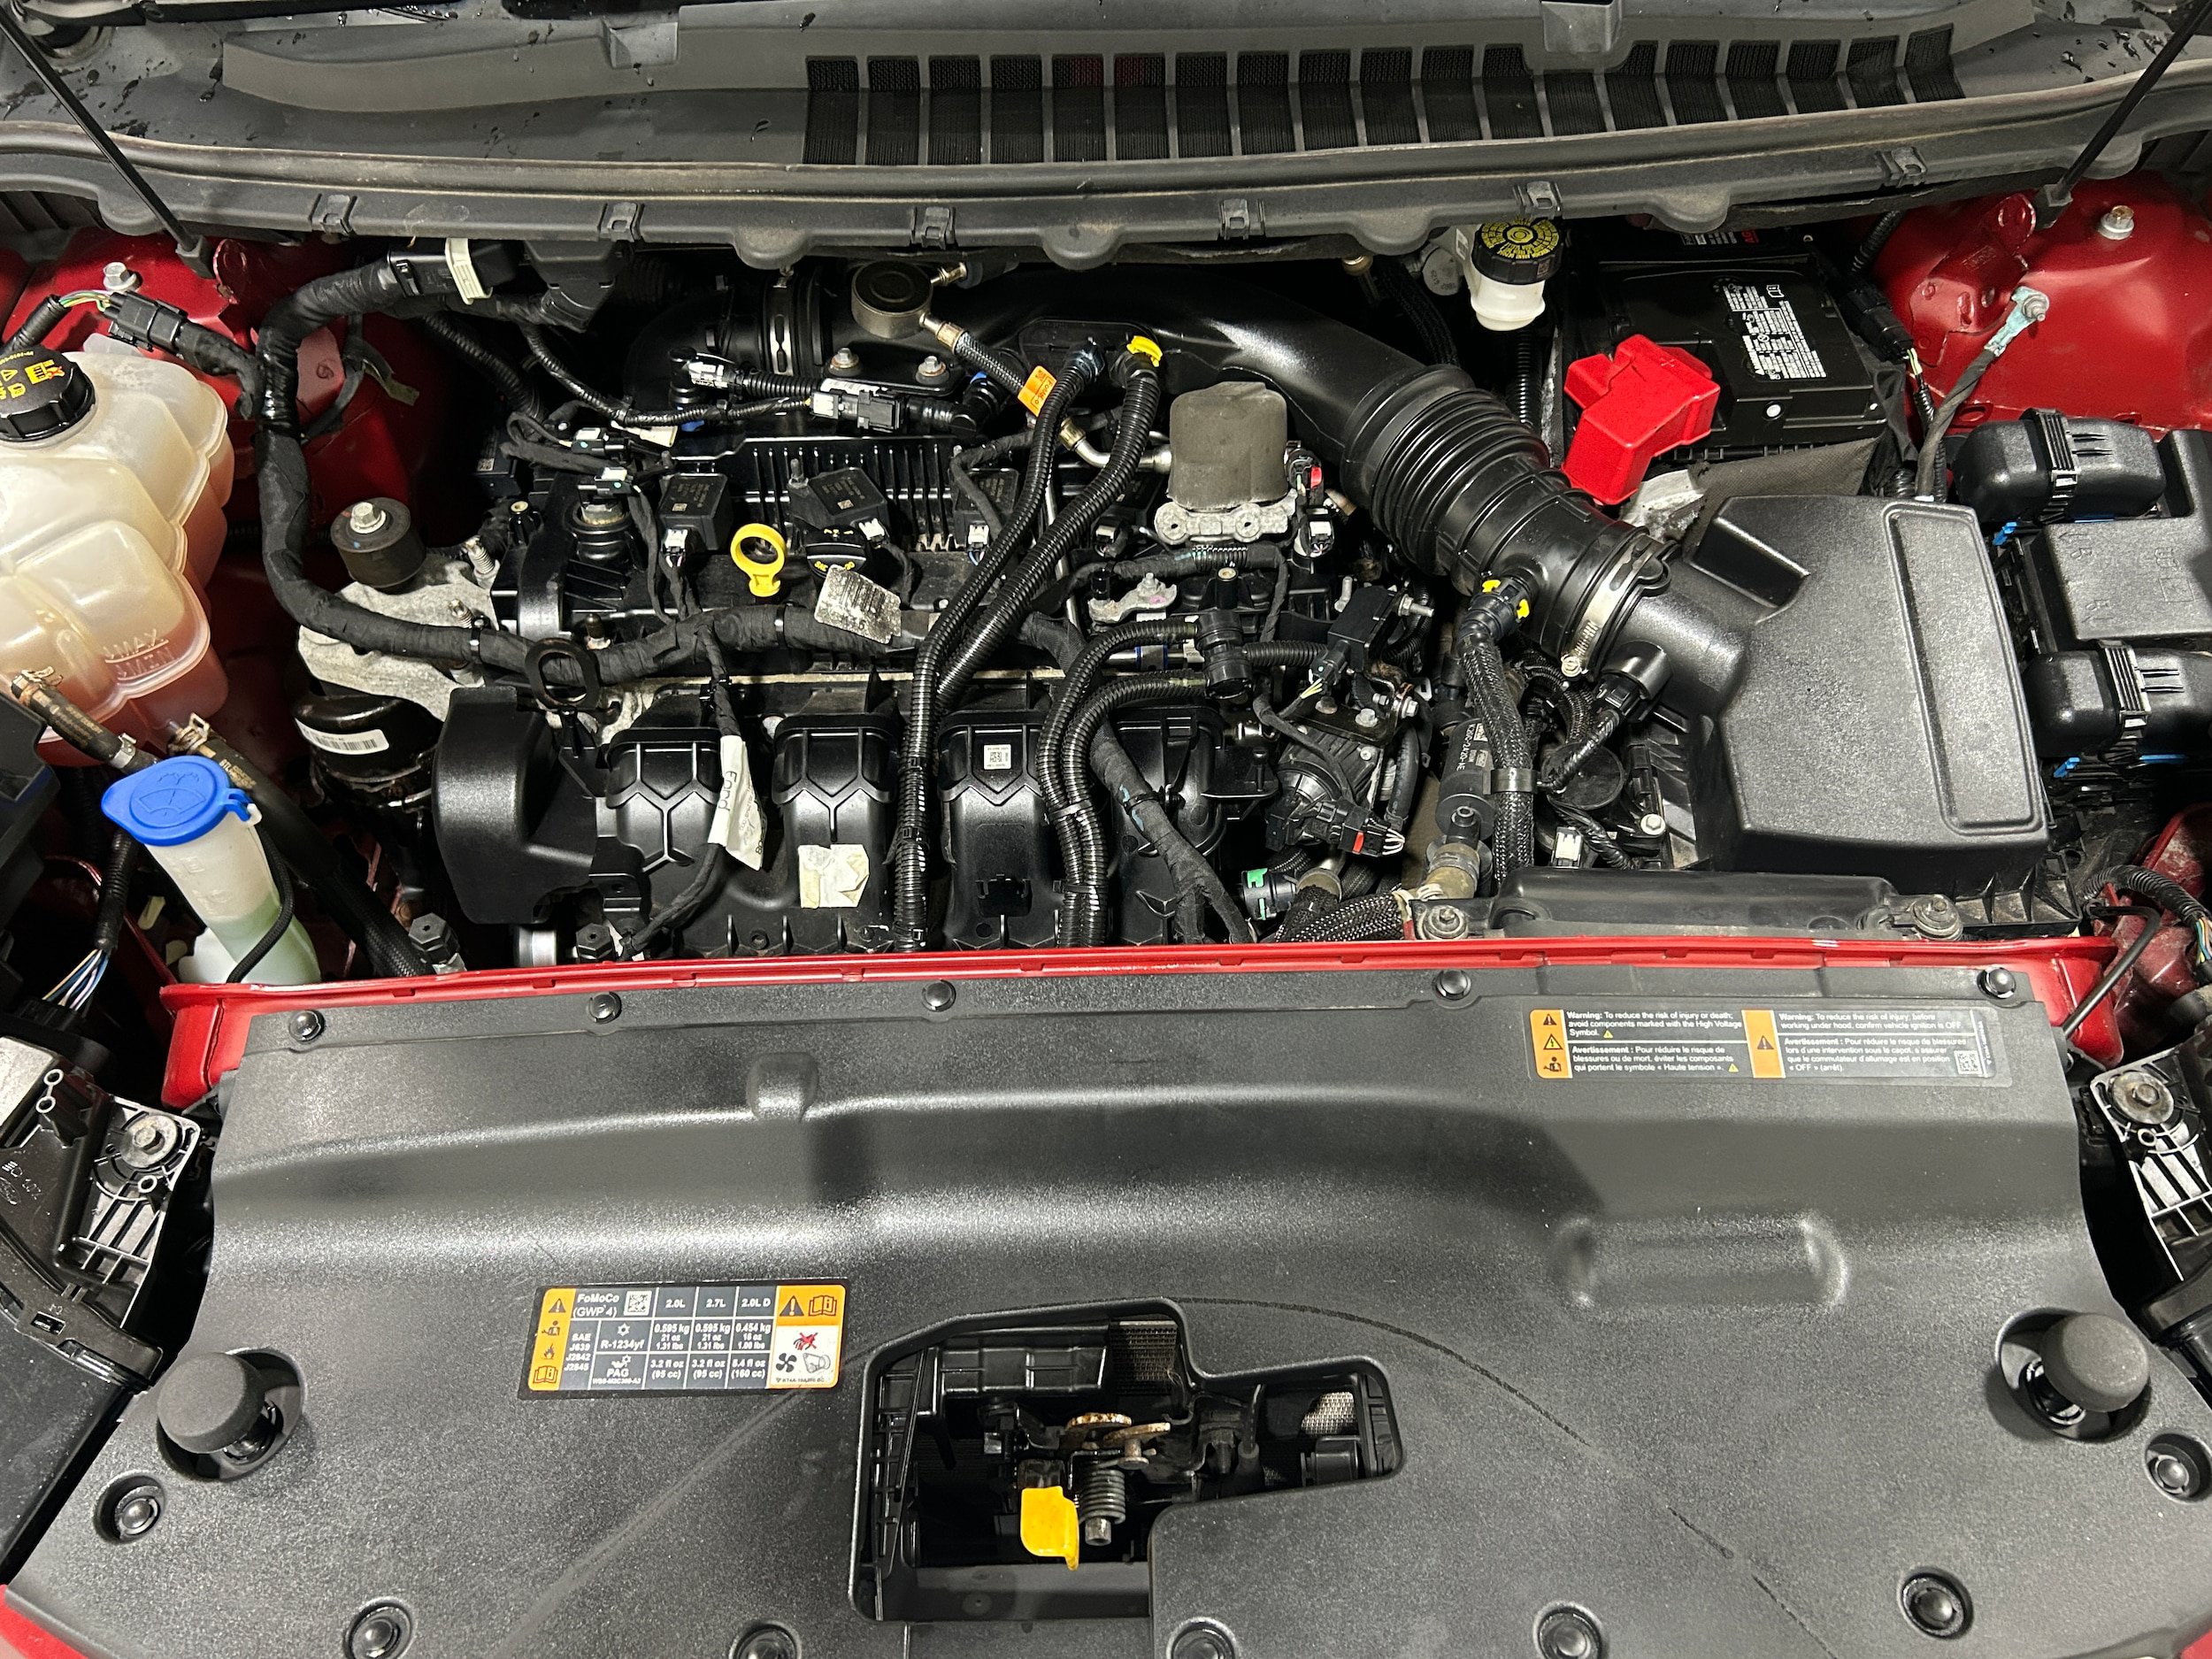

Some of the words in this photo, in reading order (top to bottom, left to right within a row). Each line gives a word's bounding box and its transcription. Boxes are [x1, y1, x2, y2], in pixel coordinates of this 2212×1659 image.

[1779, 1013, 1814, 1022] Warning:
[1899, 1038, 1920, 1047] risque
[1574, 1064, 1586, 1072] qui
[1588, 1064, 1614, 1072] portent
[1624, 1064, 1655, 1072] symbole
[577, 1293, 620, 1303] FoMoCo
[741, 1298, 761, 1307] 2.0L
[763, 1298, 771, 1307] D
[665, 1299, 686, 1308] 2.0L
[706, 1298, 726, 1308] 2.7L
[655, 1324, 678, 1333] 0.595
[679, 1324, 689, 1334] kg
[695, 1324, 718, 1333] 0.595
[719, 1324, 731, 1334] kg
[735, 1323, 759, 1333] 0.454
[760, 1323, 771, 1333] kg
[601, 1340, 644, 1351] R-1234yf
[650, 1359, 664, 1368] 3.2
[692, 1359, 706, 1368] 3.2
[667, 1370, 681, 1379] cc)
[709, 1370, 723, 1379] cc)
[751, 1370, 765, 1379] cc)
